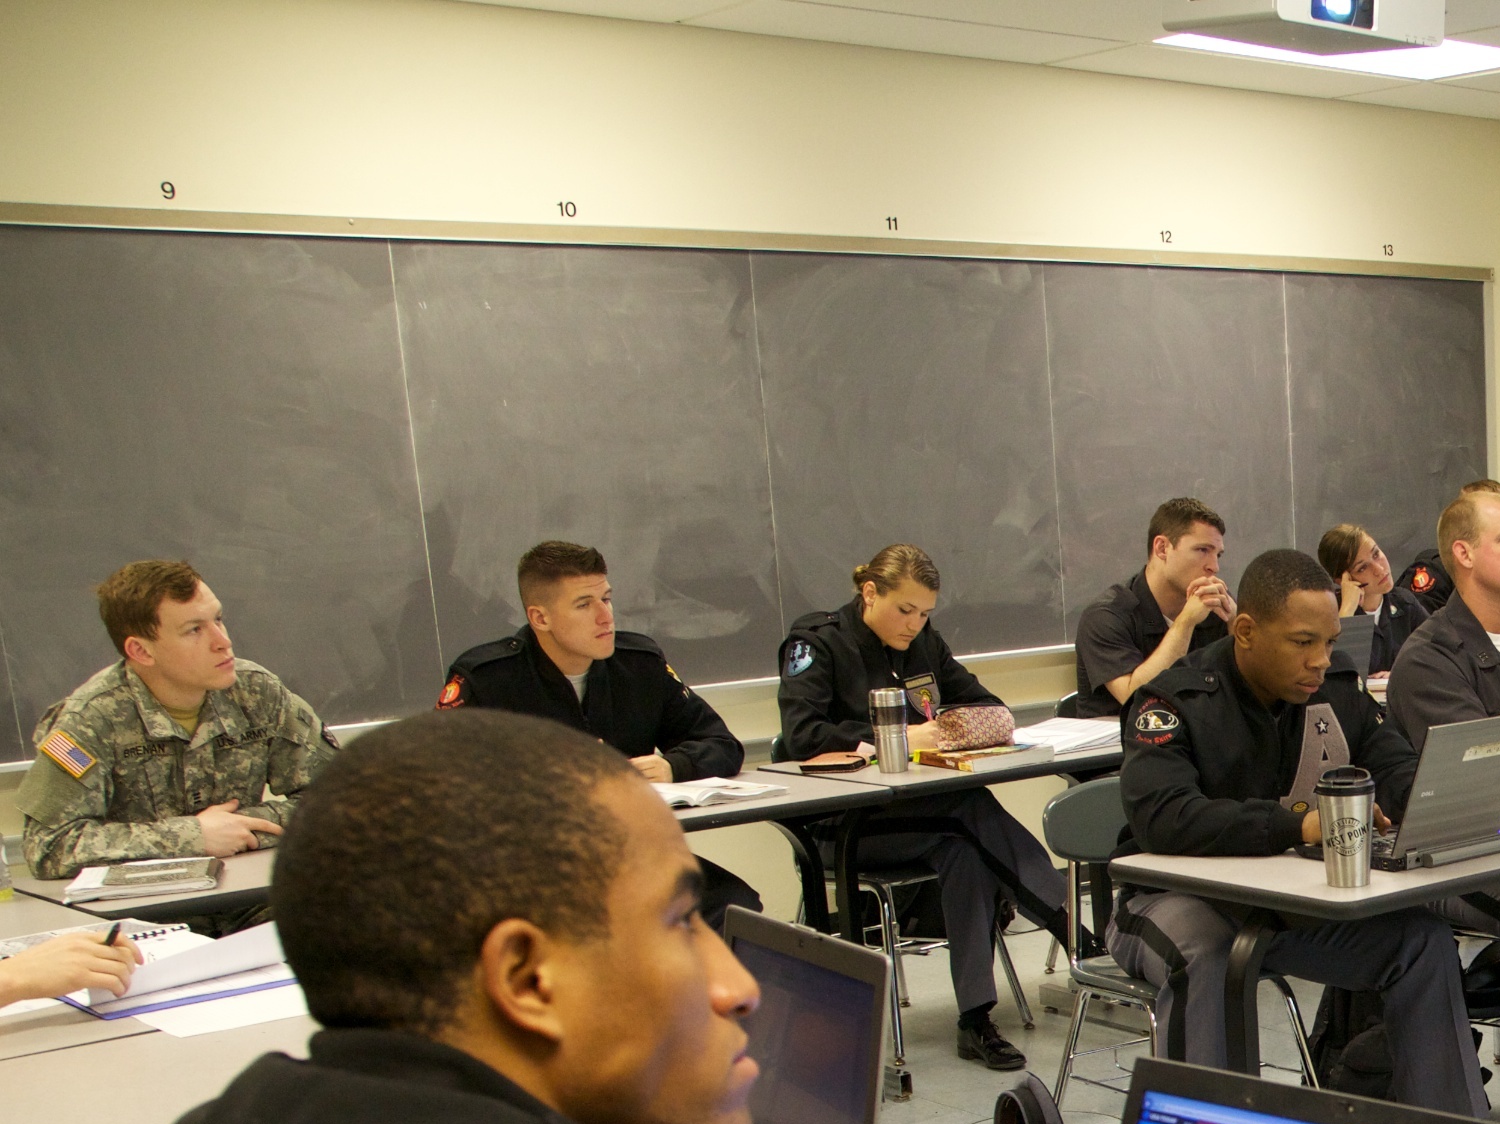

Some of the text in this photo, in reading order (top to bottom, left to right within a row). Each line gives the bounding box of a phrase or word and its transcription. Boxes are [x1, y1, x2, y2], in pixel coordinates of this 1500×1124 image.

[161, 181, 175, 200] 9
[557, 201, 576, 218] 10
[885, 216, 898, 231] 11
[1159, 230, 1172, 244] 12
[1382, 244, 1394, 257] 13
[217, 728, 268, 748] U.S. ARMY
[1326, 822, 1370, 848] WEST POINT
